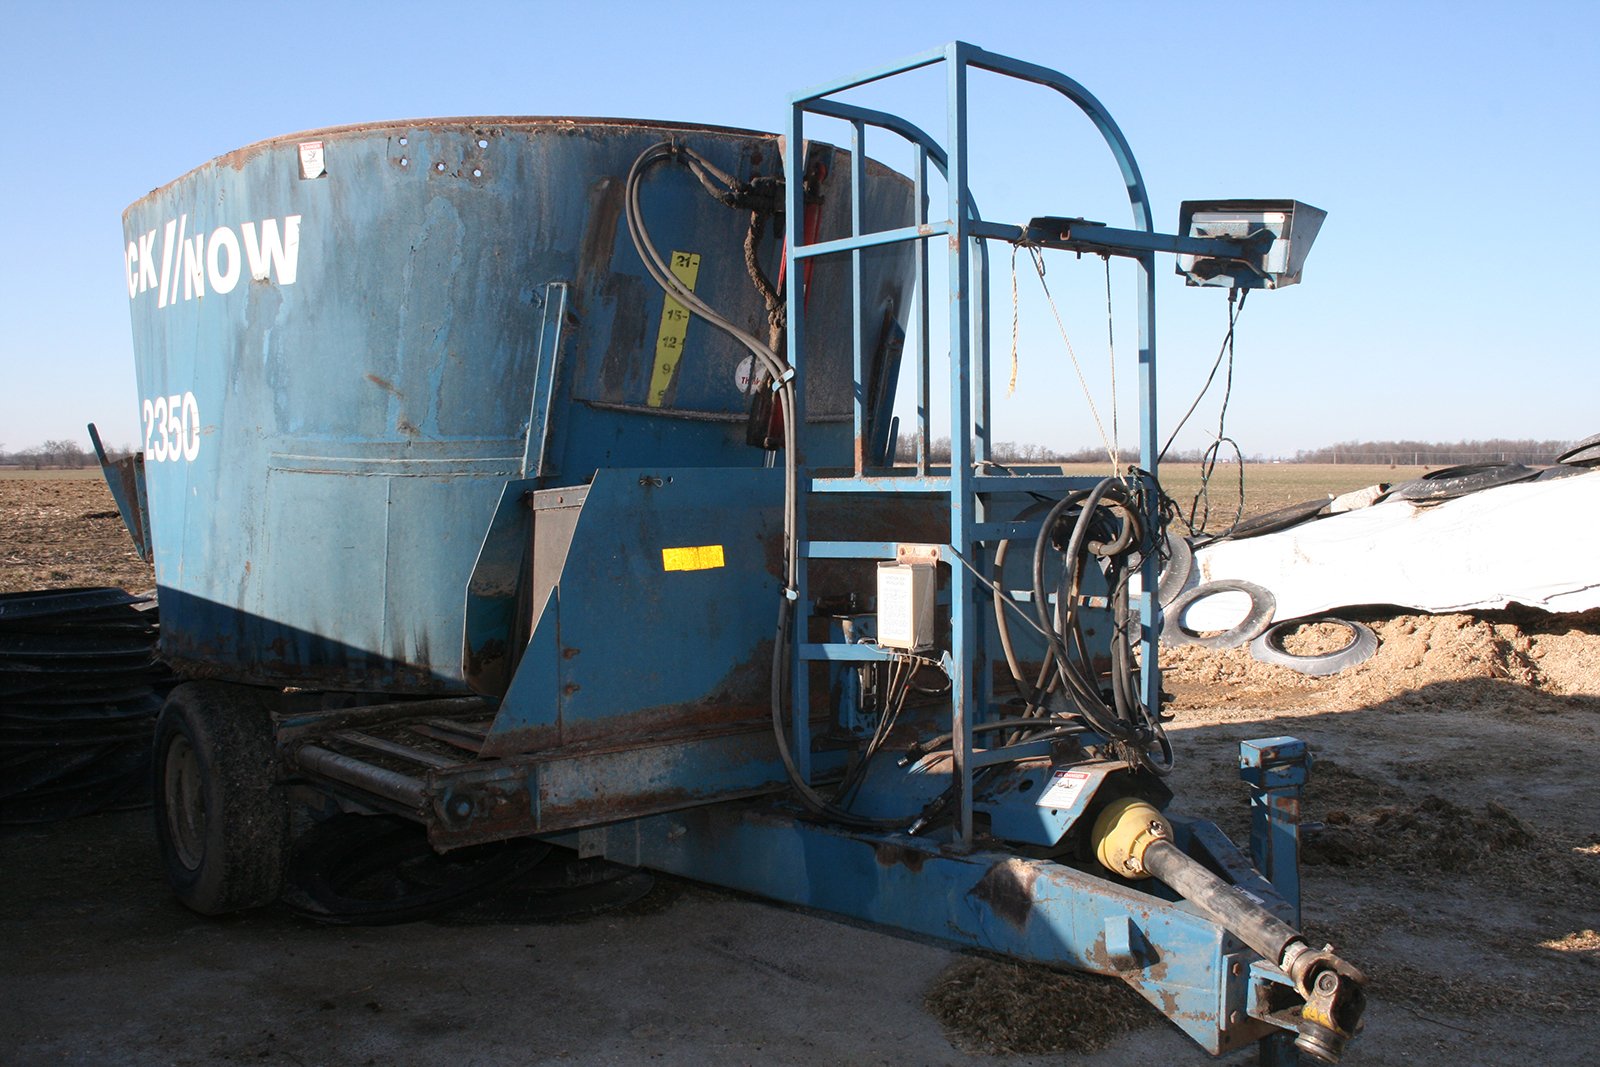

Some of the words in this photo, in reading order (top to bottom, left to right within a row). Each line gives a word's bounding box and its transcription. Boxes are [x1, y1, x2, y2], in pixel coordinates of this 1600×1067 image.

[676, 254, 691, 268] 21
[667, 310, 682, 321] 15
[662, 335, 677, 349] 12
[662, 363, 671, 375] 9
[144, 391, 200, 462] 2350
